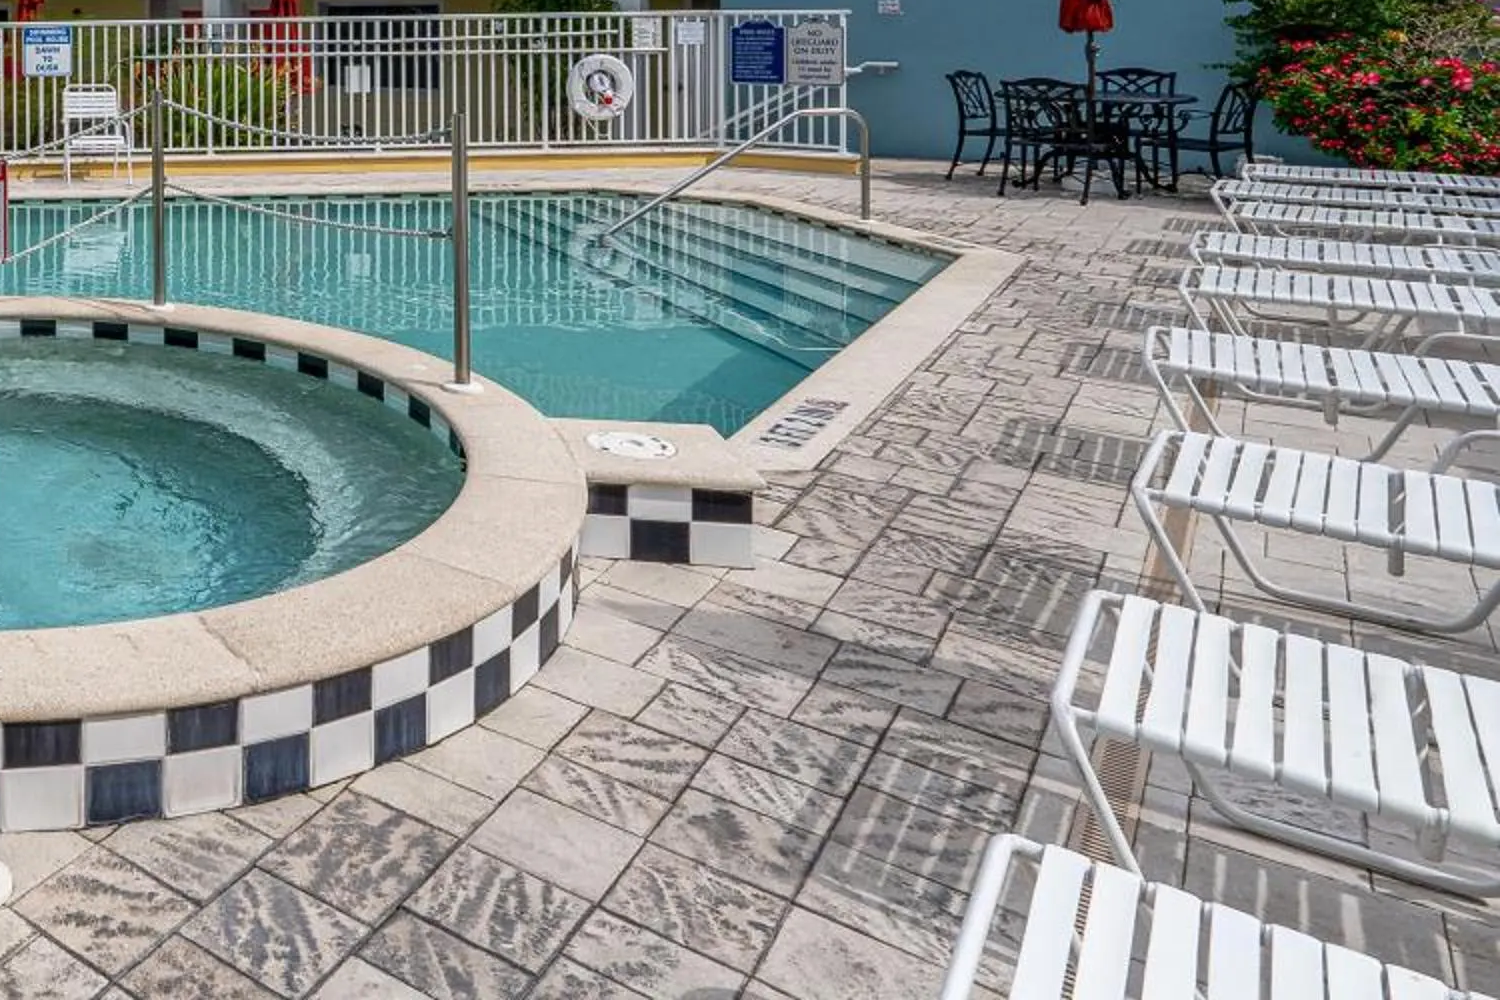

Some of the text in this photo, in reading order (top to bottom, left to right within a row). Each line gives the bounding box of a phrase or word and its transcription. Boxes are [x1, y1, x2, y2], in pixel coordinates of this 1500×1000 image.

[807, 29, 823, 37] NO
[793, 47, 837, 55] ON DUTY
